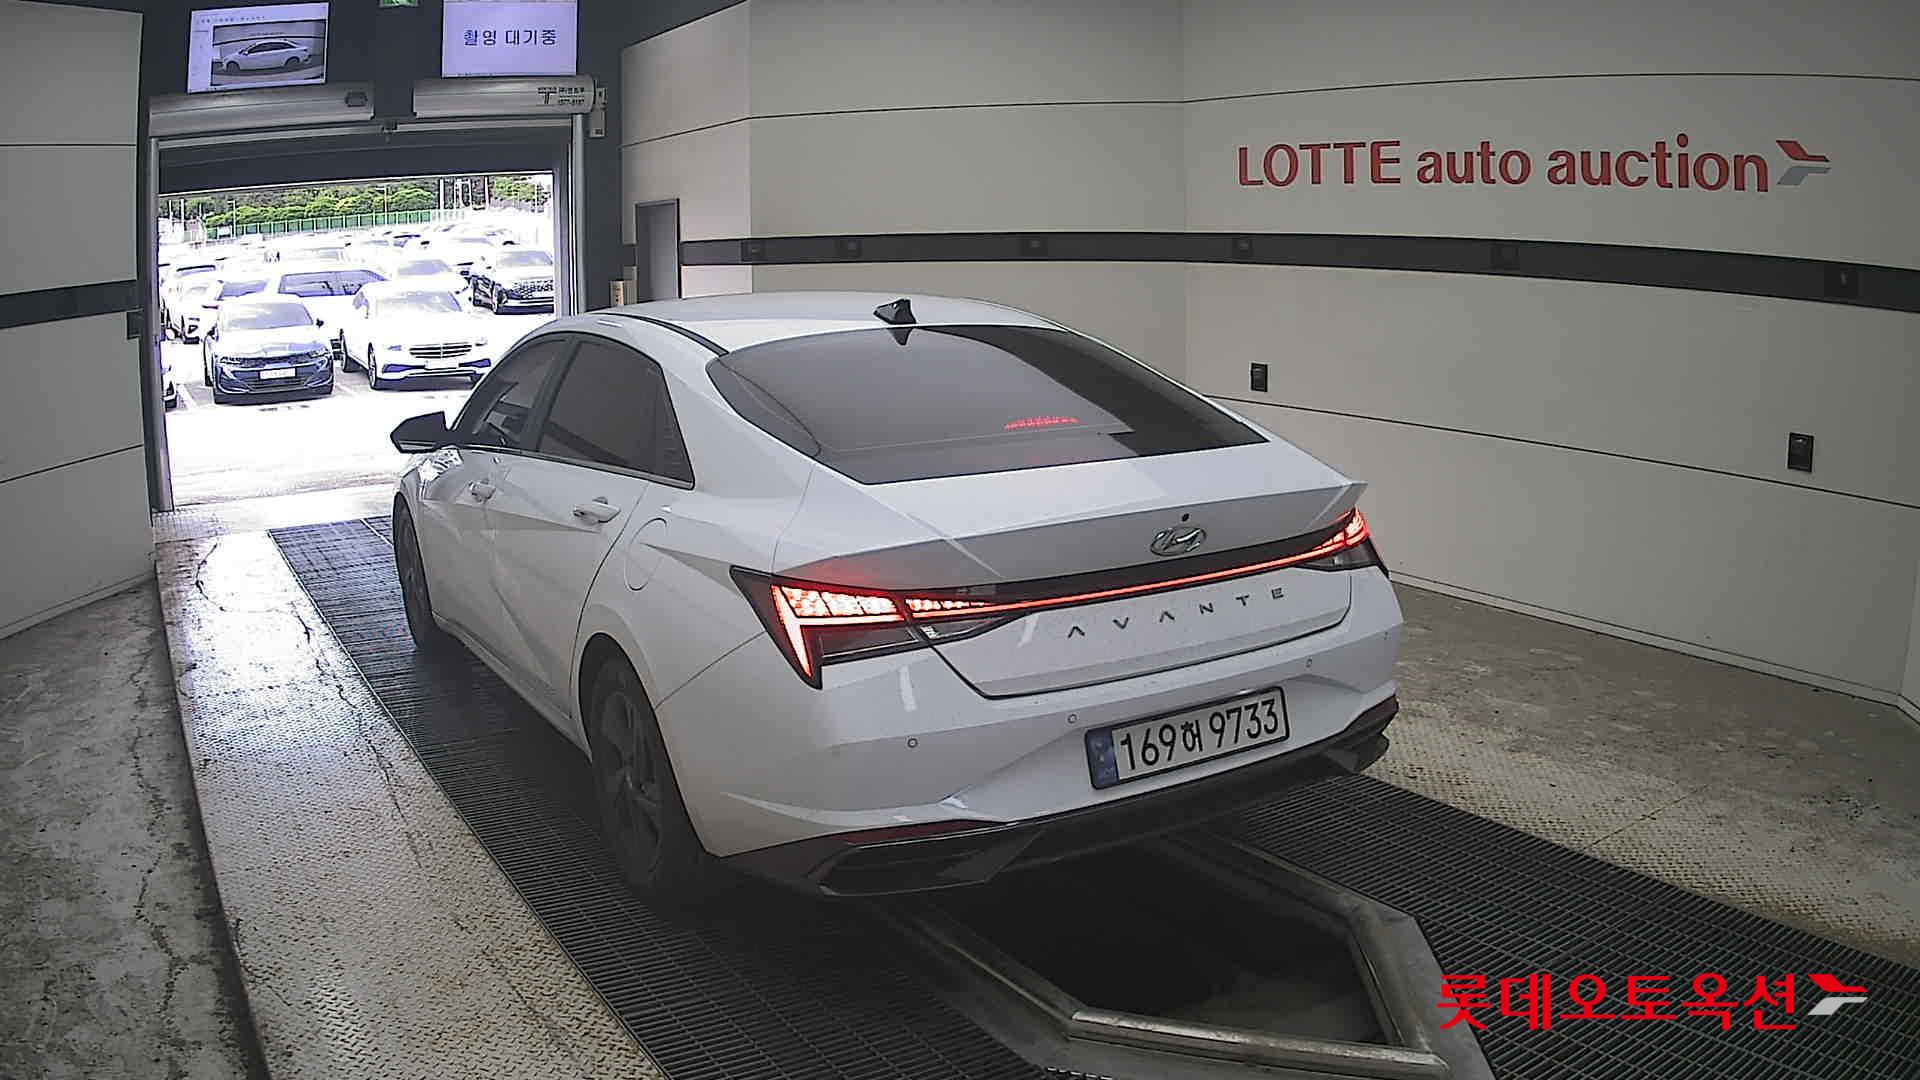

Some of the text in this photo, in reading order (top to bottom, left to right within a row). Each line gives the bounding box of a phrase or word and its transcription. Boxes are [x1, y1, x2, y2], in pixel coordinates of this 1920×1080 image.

[505, 29, 557, 46] 대기중
[1238, 133, 1769, 193] LOTTE auto auction
[1067, 587, 1285, 639] AVANTE
[1120, 698, 1279, 770] 169허 9733
